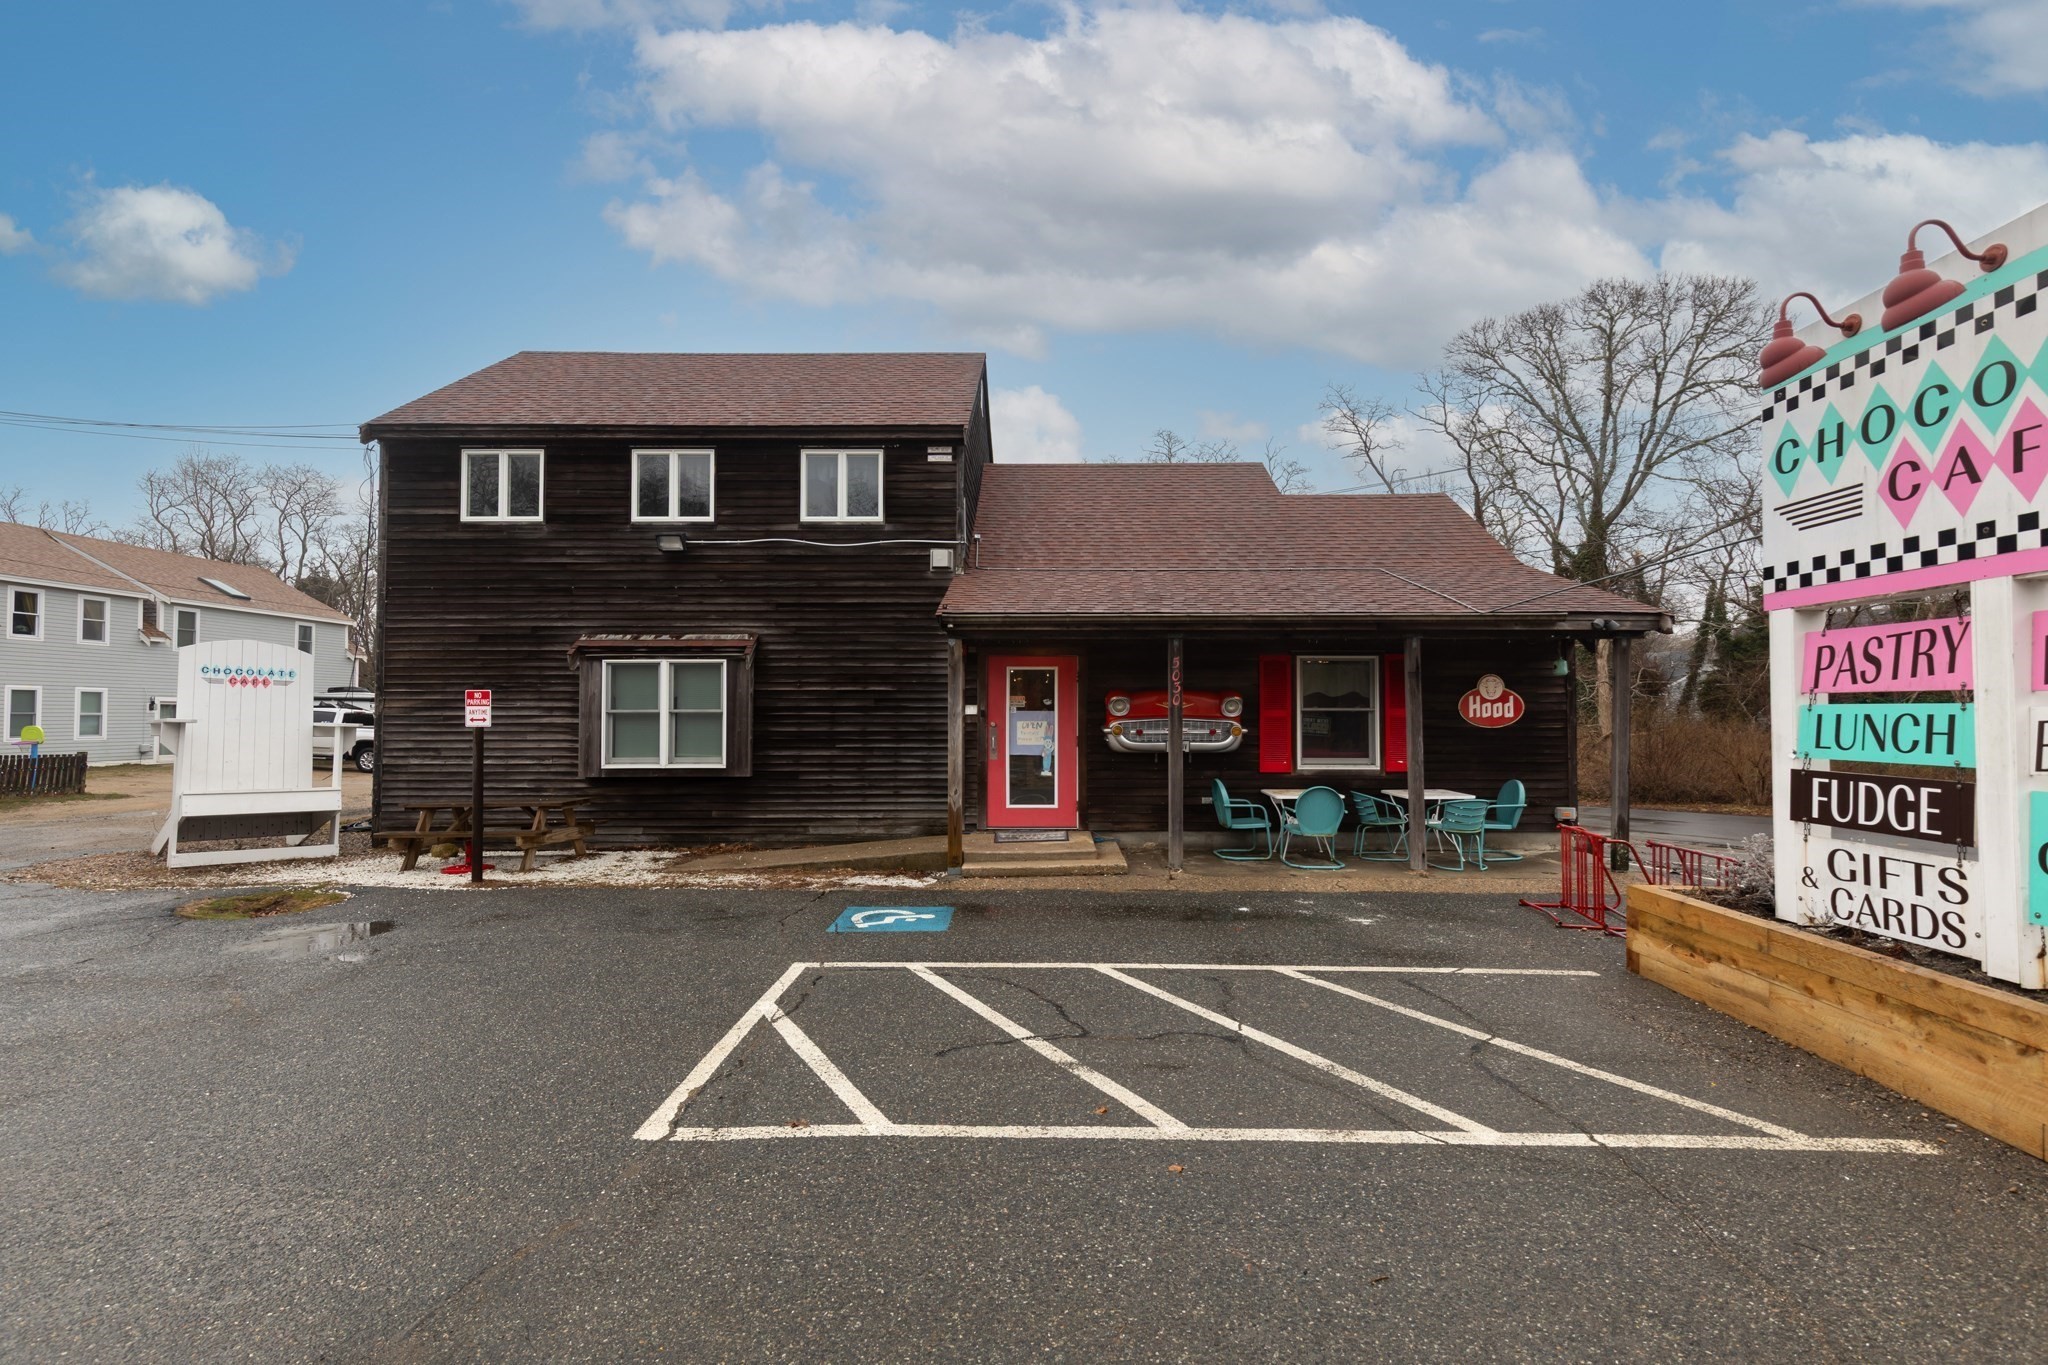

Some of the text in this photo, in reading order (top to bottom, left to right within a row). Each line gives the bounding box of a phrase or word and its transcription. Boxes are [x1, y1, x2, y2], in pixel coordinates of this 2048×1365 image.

[201, 666, 296, 678] CHOCOLATE
[1813, 620, 1971, 689] PASTRY
[466, 698, 490, 706] PARKING
[1171, 656, 1181, 706] 5030
[1468, 695, 1514, 718] Hood
[1814, 713, 1957, 755] LUNCH
[1811, 777, 1943, 836] FUDGE
[1801, 848, 1970, 905] & GIFTS
[1830, 887, 1967, 949] CARDS
